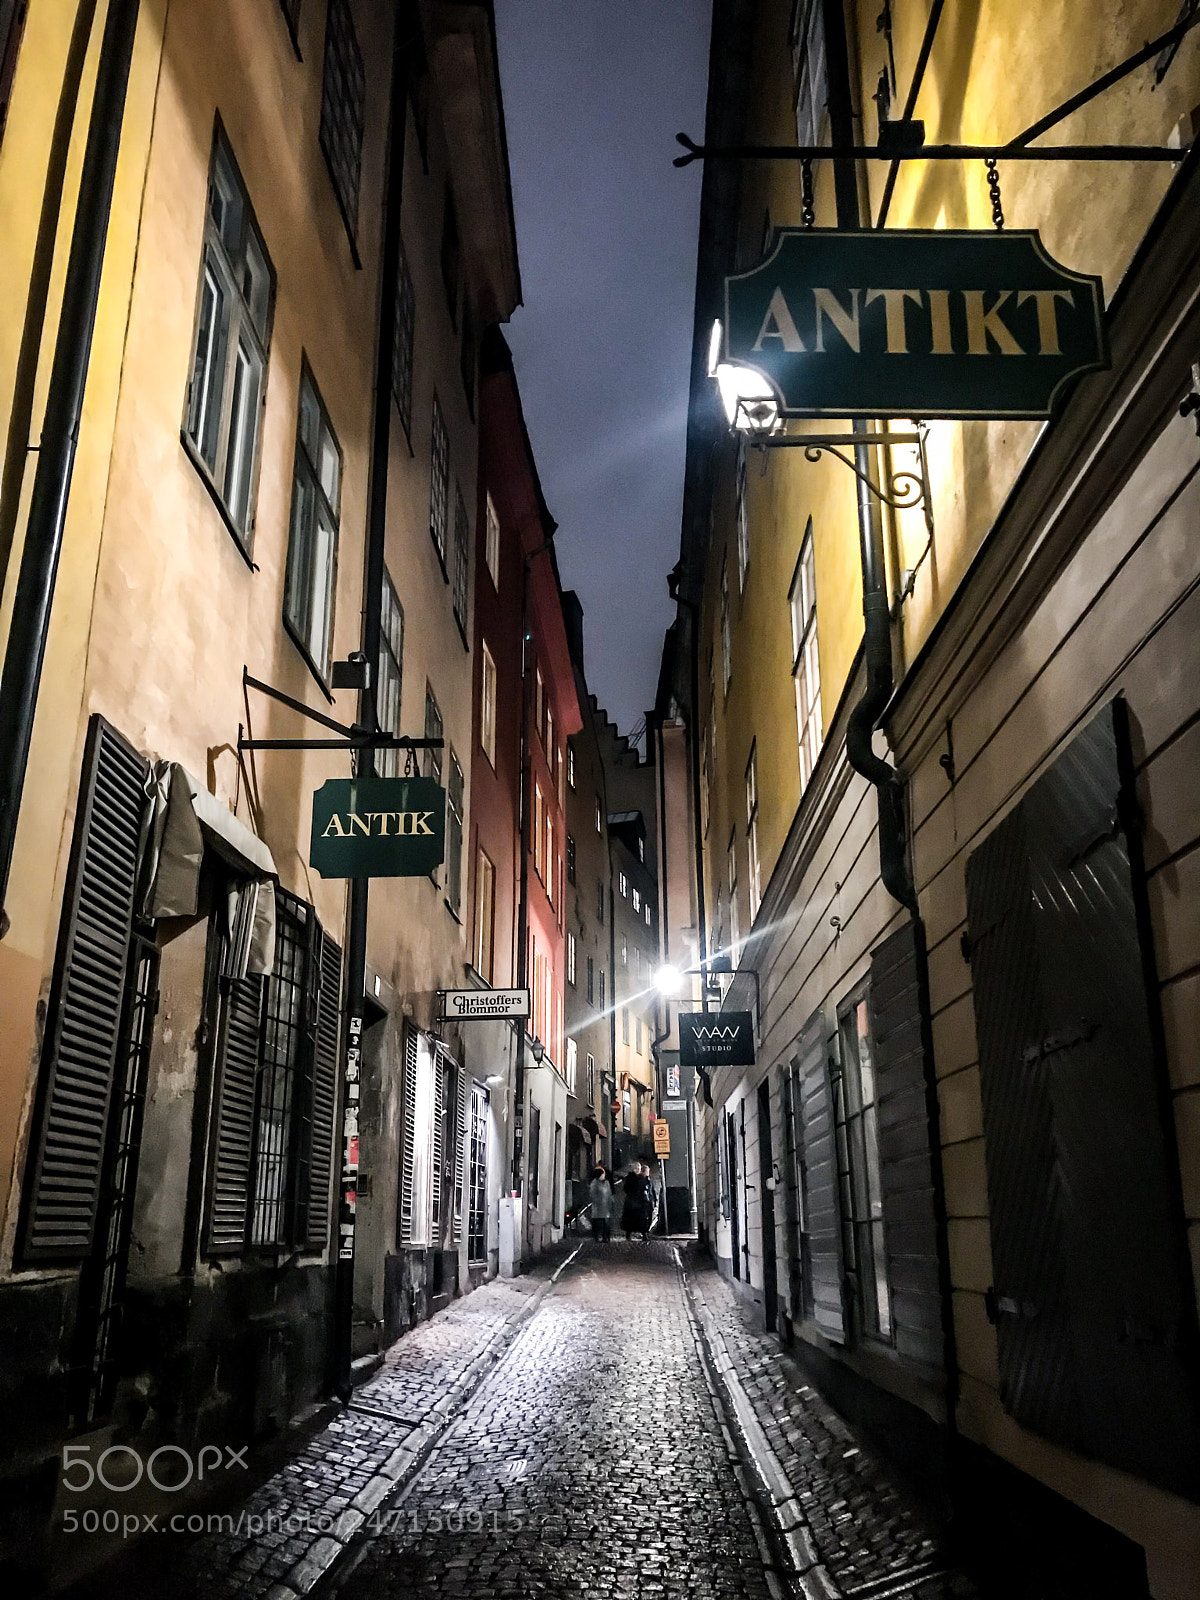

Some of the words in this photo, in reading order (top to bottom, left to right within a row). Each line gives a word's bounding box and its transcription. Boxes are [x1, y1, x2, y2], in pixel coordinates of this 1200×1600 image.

[751, 285, 1076, 355] ANTIKT
[320, 811, 436, 838] ANTIK
[452, 995, 522, 1007] Christoffers
[458, 1003, 511, 1015] Blommor
